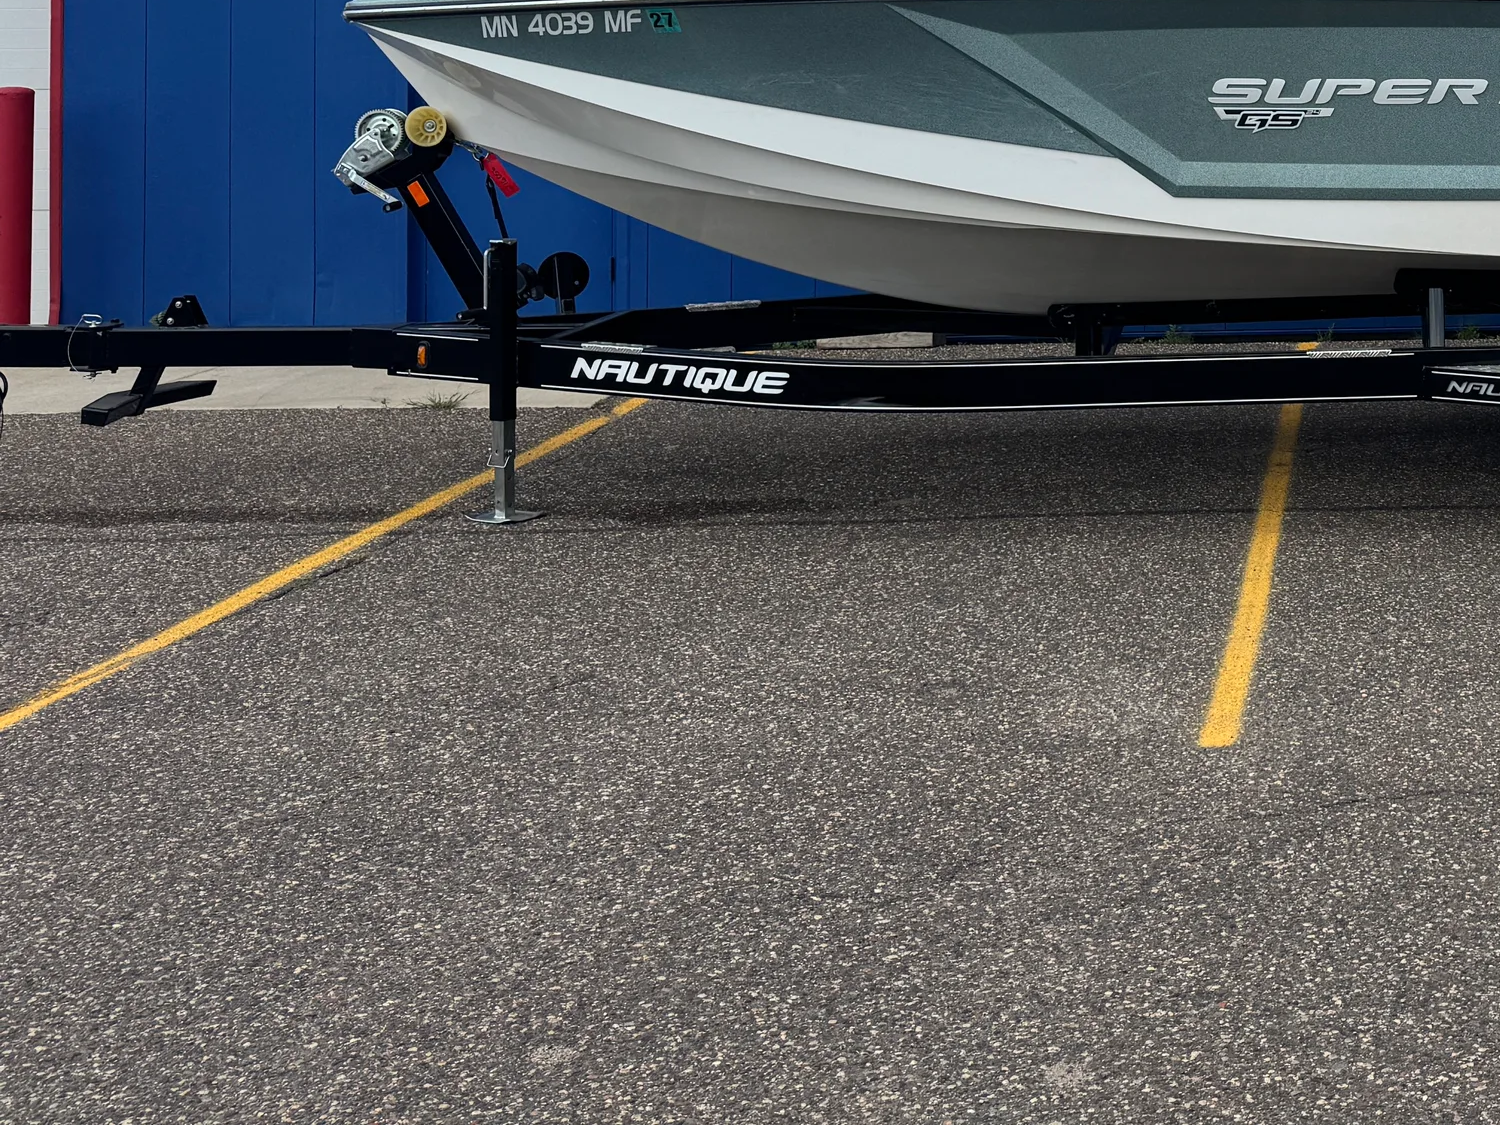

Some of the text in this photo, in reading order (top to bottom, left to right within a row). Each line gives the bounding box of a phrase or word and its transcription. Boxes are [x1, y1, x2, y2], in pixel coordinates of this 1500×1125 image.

[480, 9, 673, 38] MN 4039 MF 27
[1207, 77, 1489, 105] SUPER
[570, 356, 790, 395] NAUTIQUE
